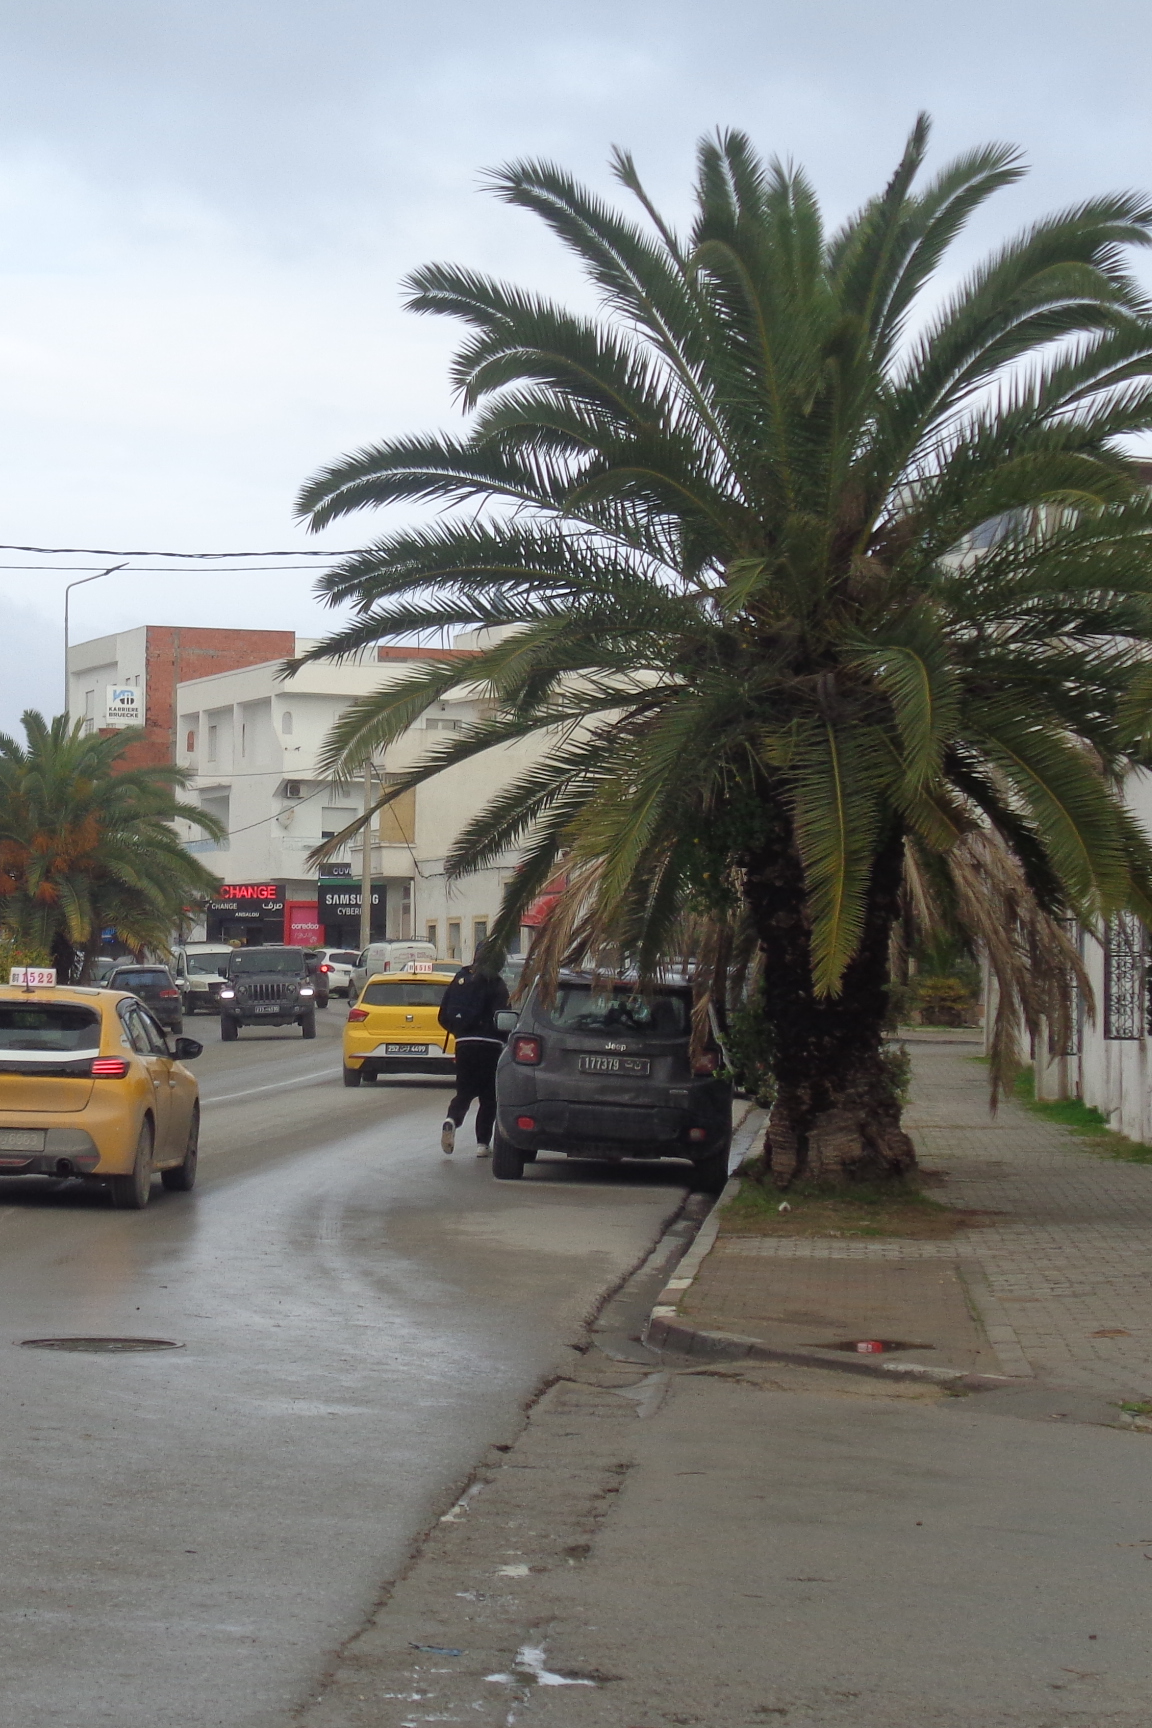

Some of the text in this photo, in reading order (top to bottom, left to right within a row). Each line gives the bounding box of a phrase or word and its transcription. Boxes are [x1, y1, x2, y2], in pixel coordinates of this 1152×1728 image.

[220, 885, 277, 899] CHANGE
[325, 894, 379, 905] SAMSUG
[211, 902, 238, 910] CHANGE
[262, 901, 283, 912] صرف
[291, 922, 319, 930] ooredoo
[22, 972, 54, 984] 1522
[605, 1042, 627, 1051] Jeep
[585, 1058, 620, 1071] 177379
